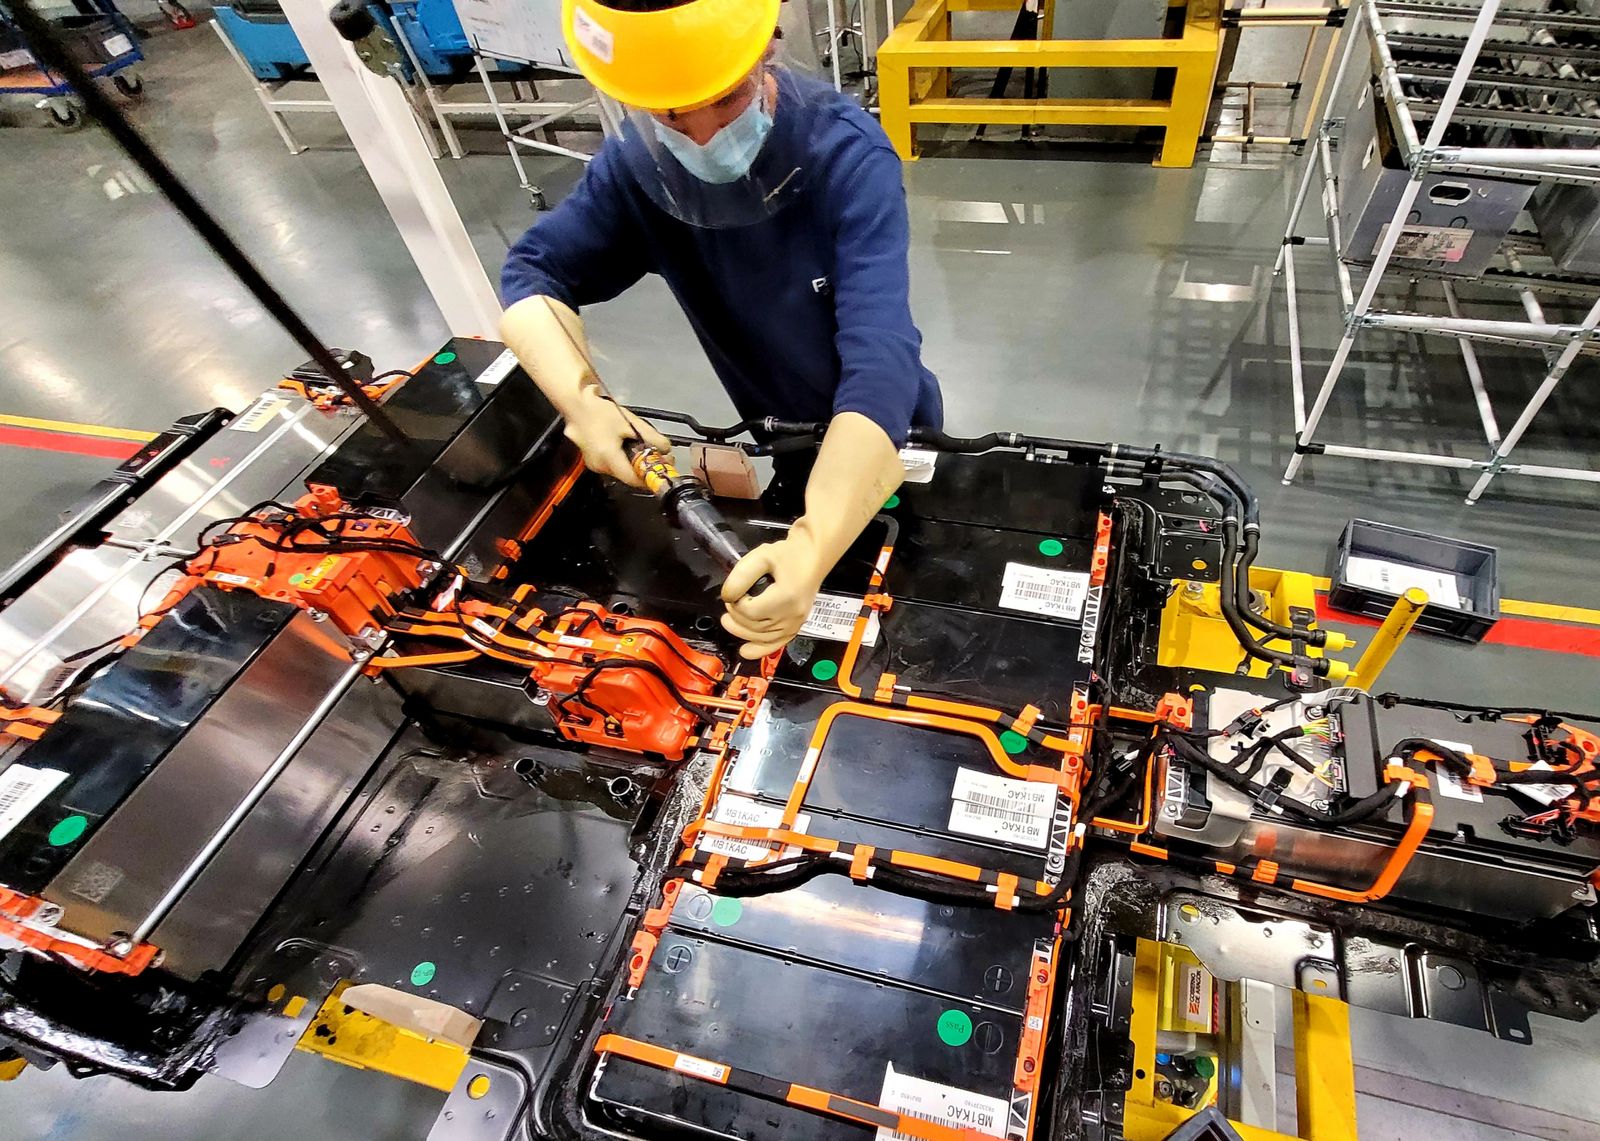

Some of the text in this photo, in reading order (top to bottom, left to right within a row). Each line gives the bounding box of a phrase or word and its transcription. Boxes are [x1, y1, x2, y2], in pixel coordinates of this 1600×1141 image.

[1007, 790, 1045, 803] MB1KAC
[725, 808, 760, 823] MB1KAC
[1002, 821, 1040, 836] MB1KAC
[711, 839, 748, 855] MB1KAC
[945, 1020, 965, 1034] Pass
[947, 1105, 993, 1128] MB1KAC
